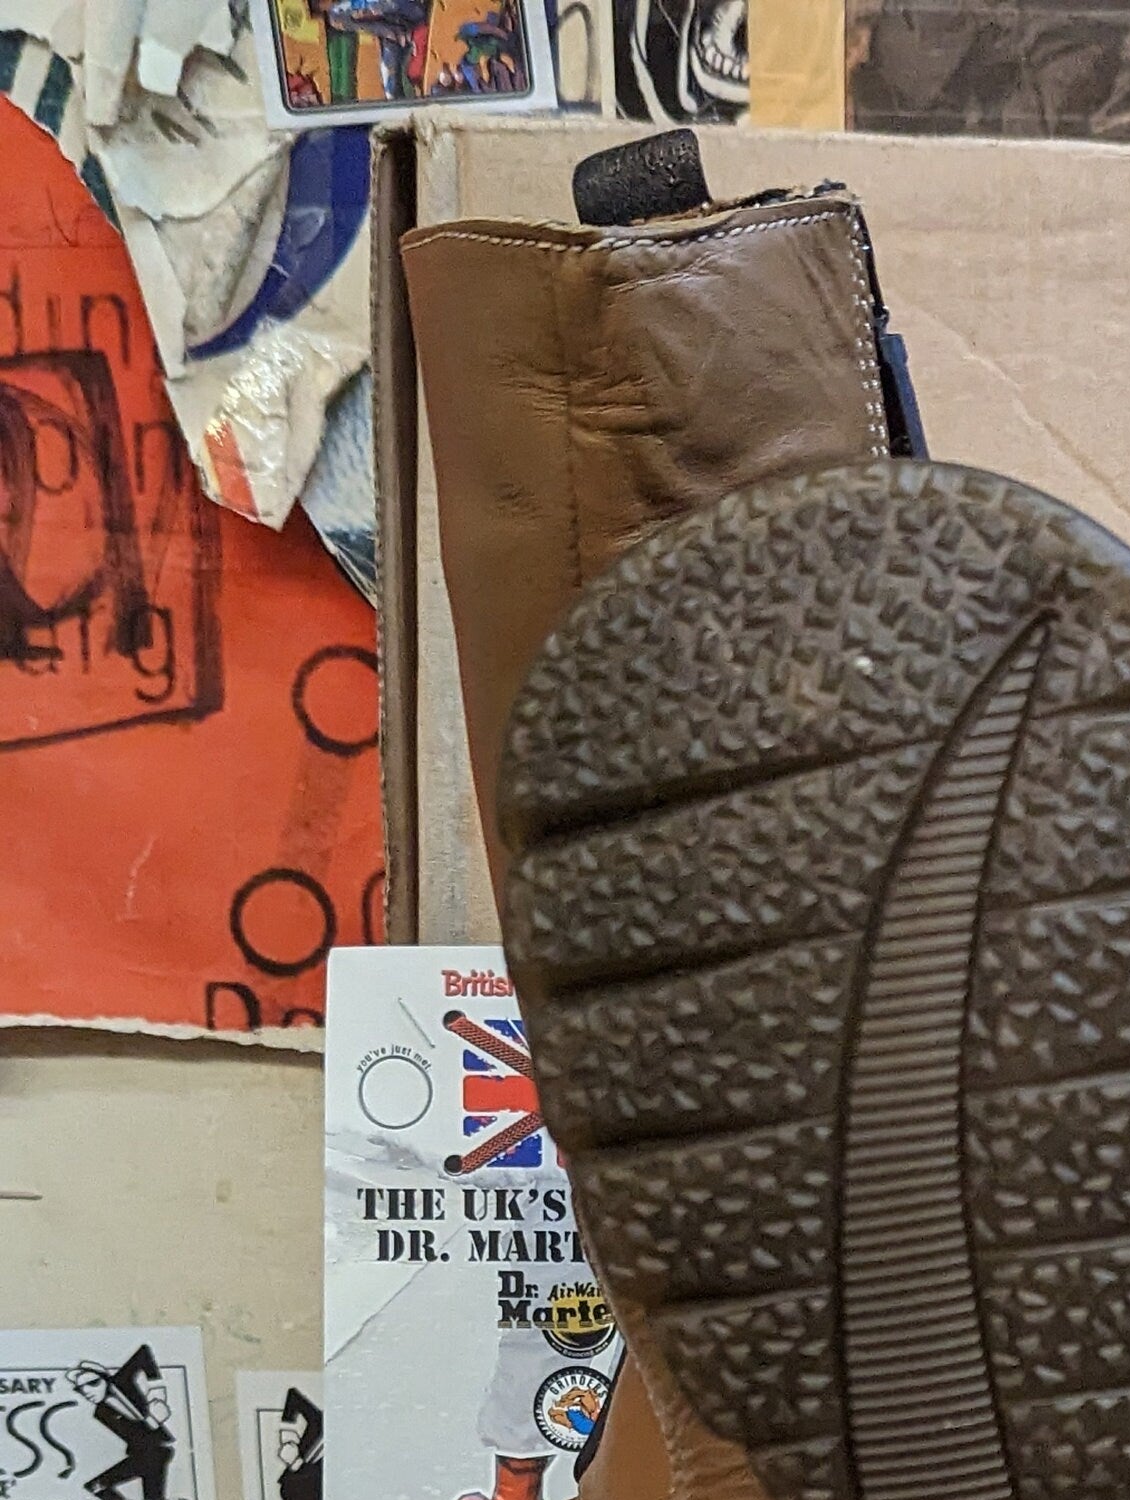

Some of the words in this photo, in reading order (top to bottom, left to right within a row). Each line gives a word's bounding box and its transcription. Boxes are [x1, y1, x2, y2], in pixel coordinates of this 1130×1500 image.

[356, 1046, 387, 1073] you've
[391, 1043, 412, 1057] just
[413, 1051, 432, 1071] met
[357, 1188, 446, 1221] THE
[462, 1188, 567, 1222] UK'S
[376, 1229, 451, 1262] DR.
[497, 1270, 540, 1299] Dr.
[550, 1374, 609, 1400] GRINDERS
